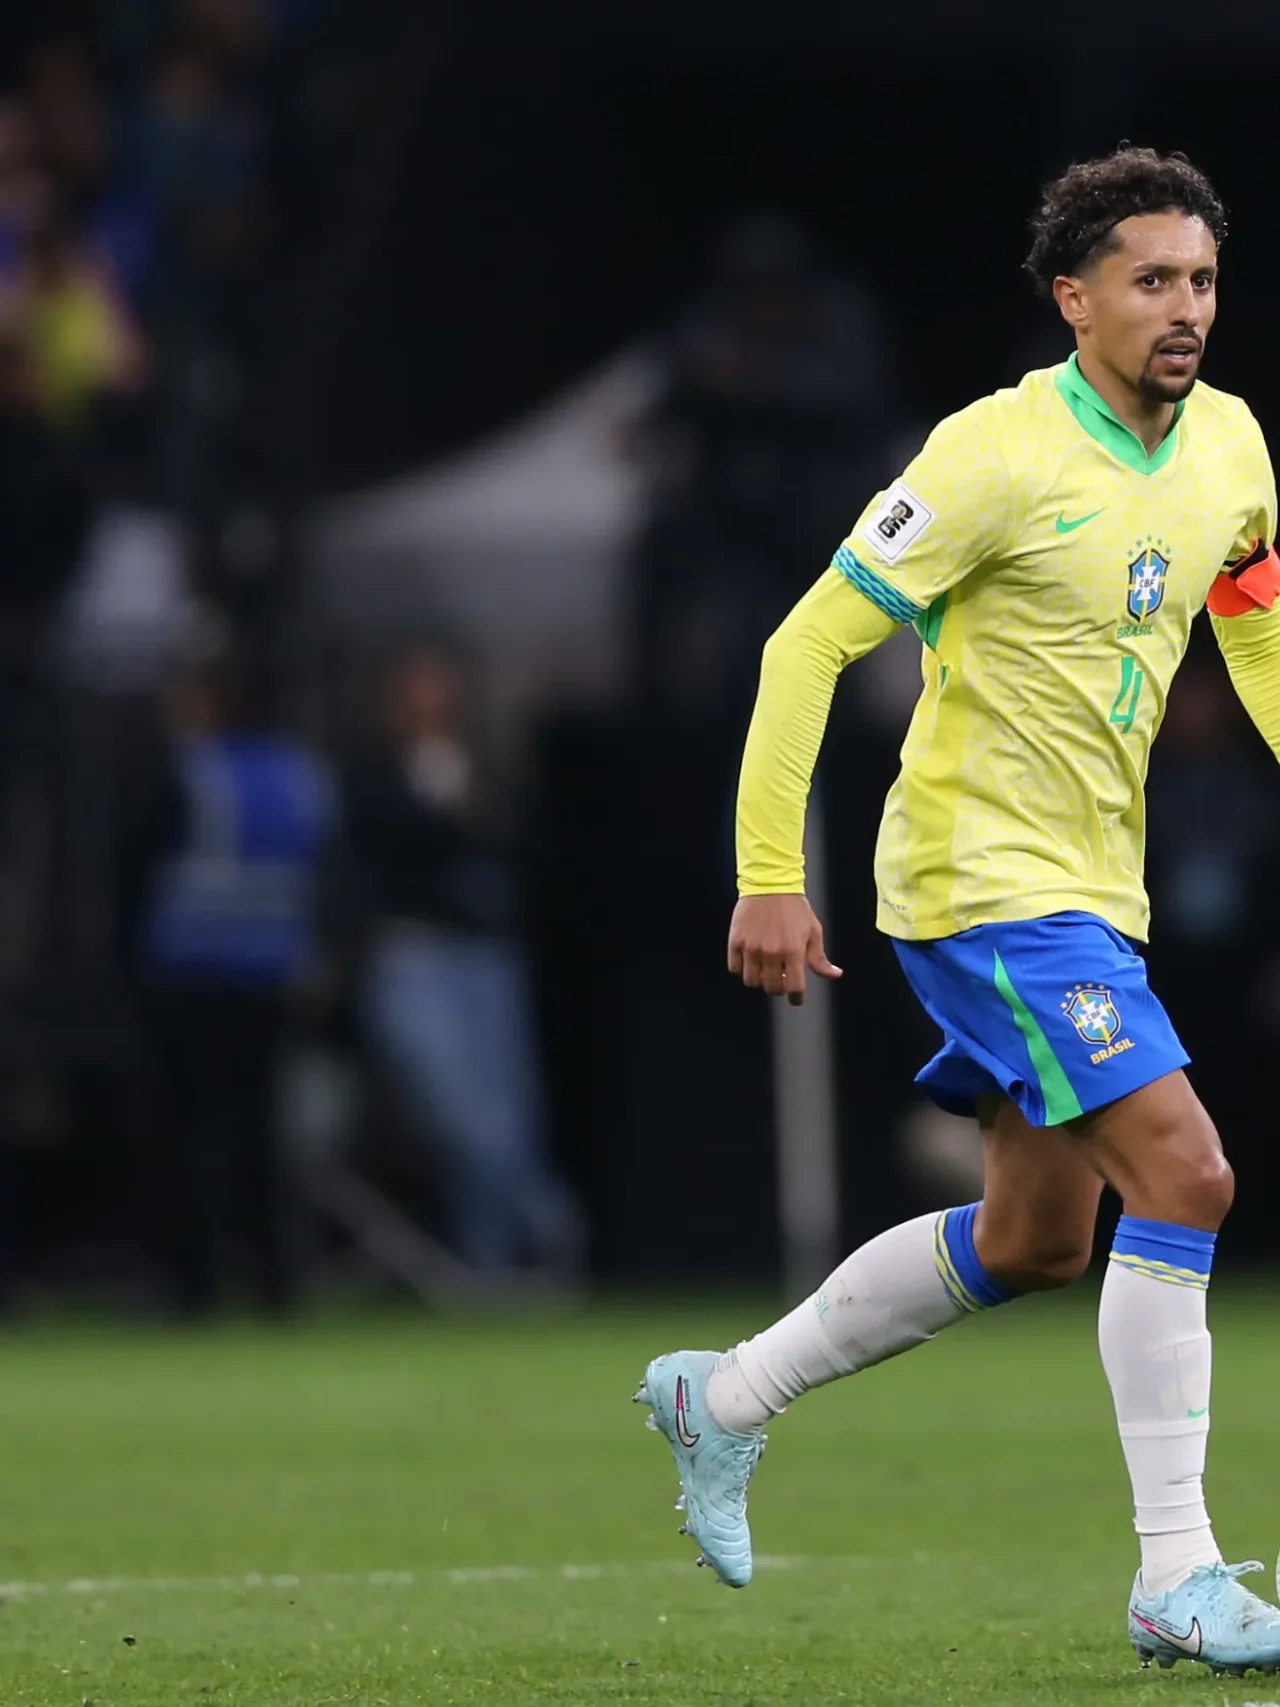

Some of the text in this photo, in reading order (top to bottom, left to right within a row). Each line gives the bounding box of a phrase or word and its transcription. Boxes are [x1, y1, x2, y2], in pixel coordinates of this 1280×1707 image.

[1138, 578, 1155, 588] CBF
[1116, 622, 1153, 640] BRASIL
[1109, 656, 1144, 734] 4
[1090, 1037, 1136, 1065] BRASIL
